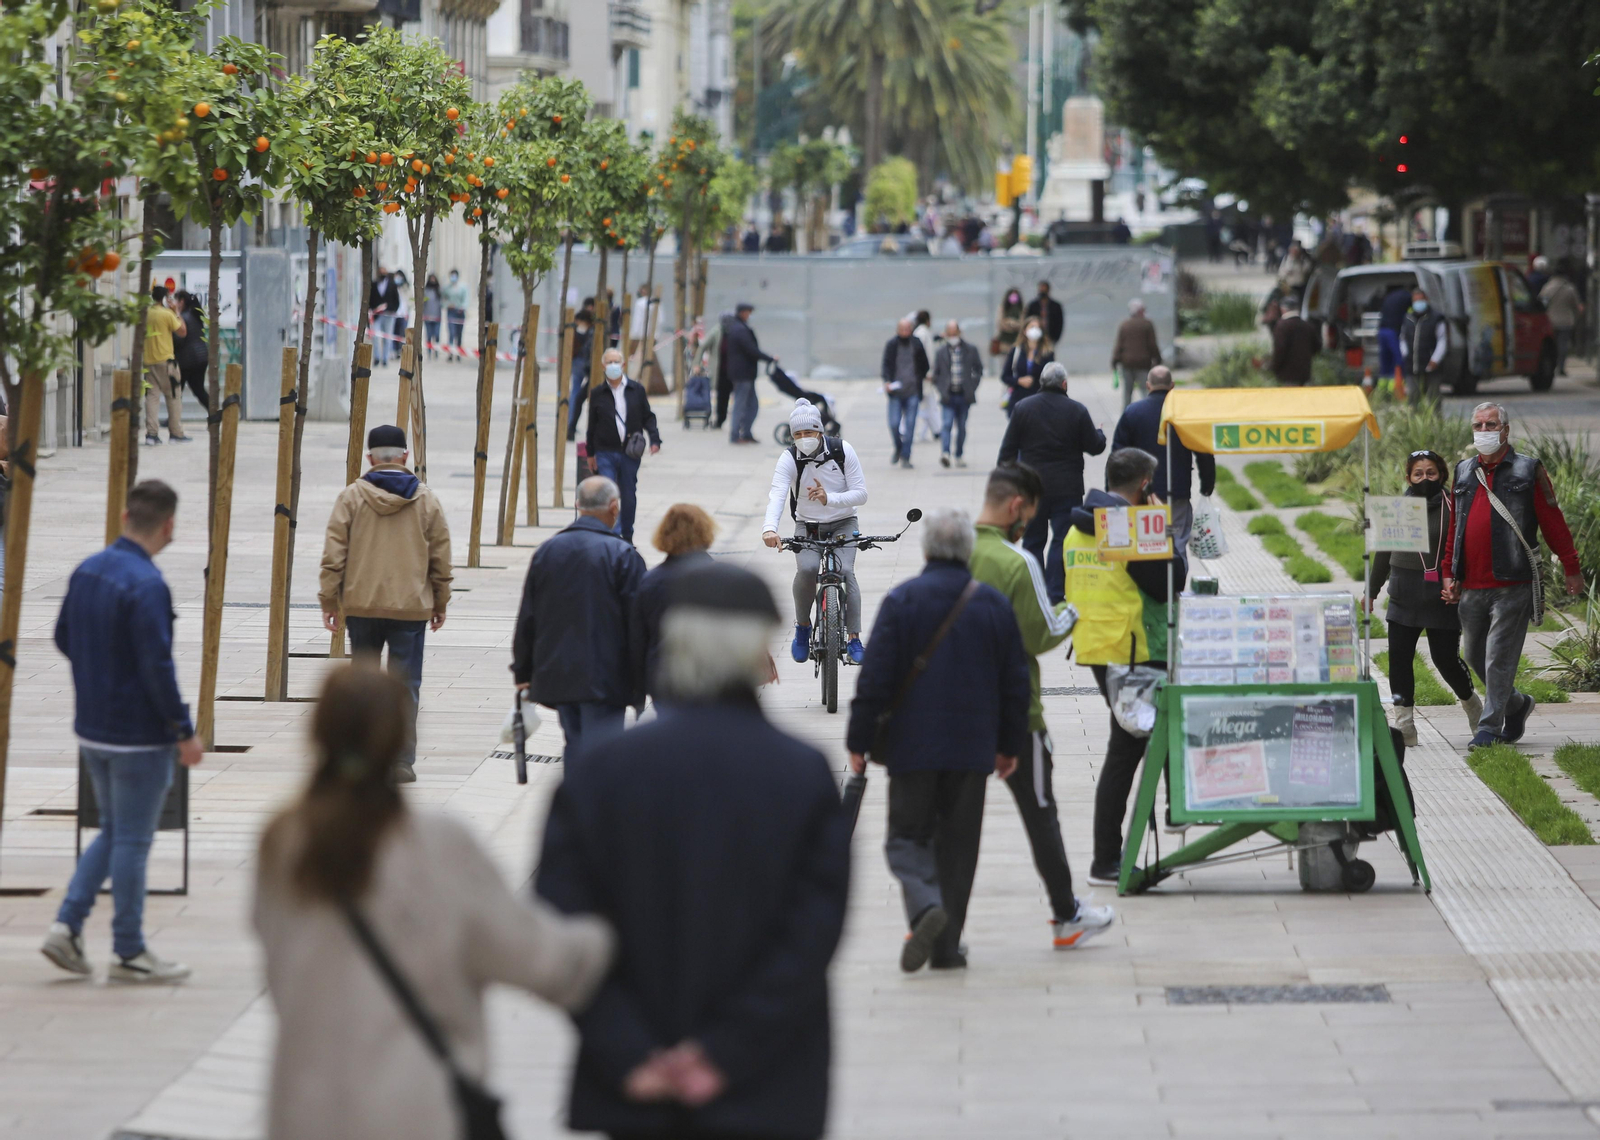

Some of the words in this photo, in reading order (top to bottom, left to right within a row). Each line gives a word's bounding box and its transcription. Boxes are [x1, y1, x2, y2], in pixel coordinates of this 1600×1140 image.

[1245, 427, 1316, 445] ONCE
[1141, 514, 1165, 535] 10
[1077, 552, 1107, 566] ONC
[1211, 717, 1257, 739] Mega
